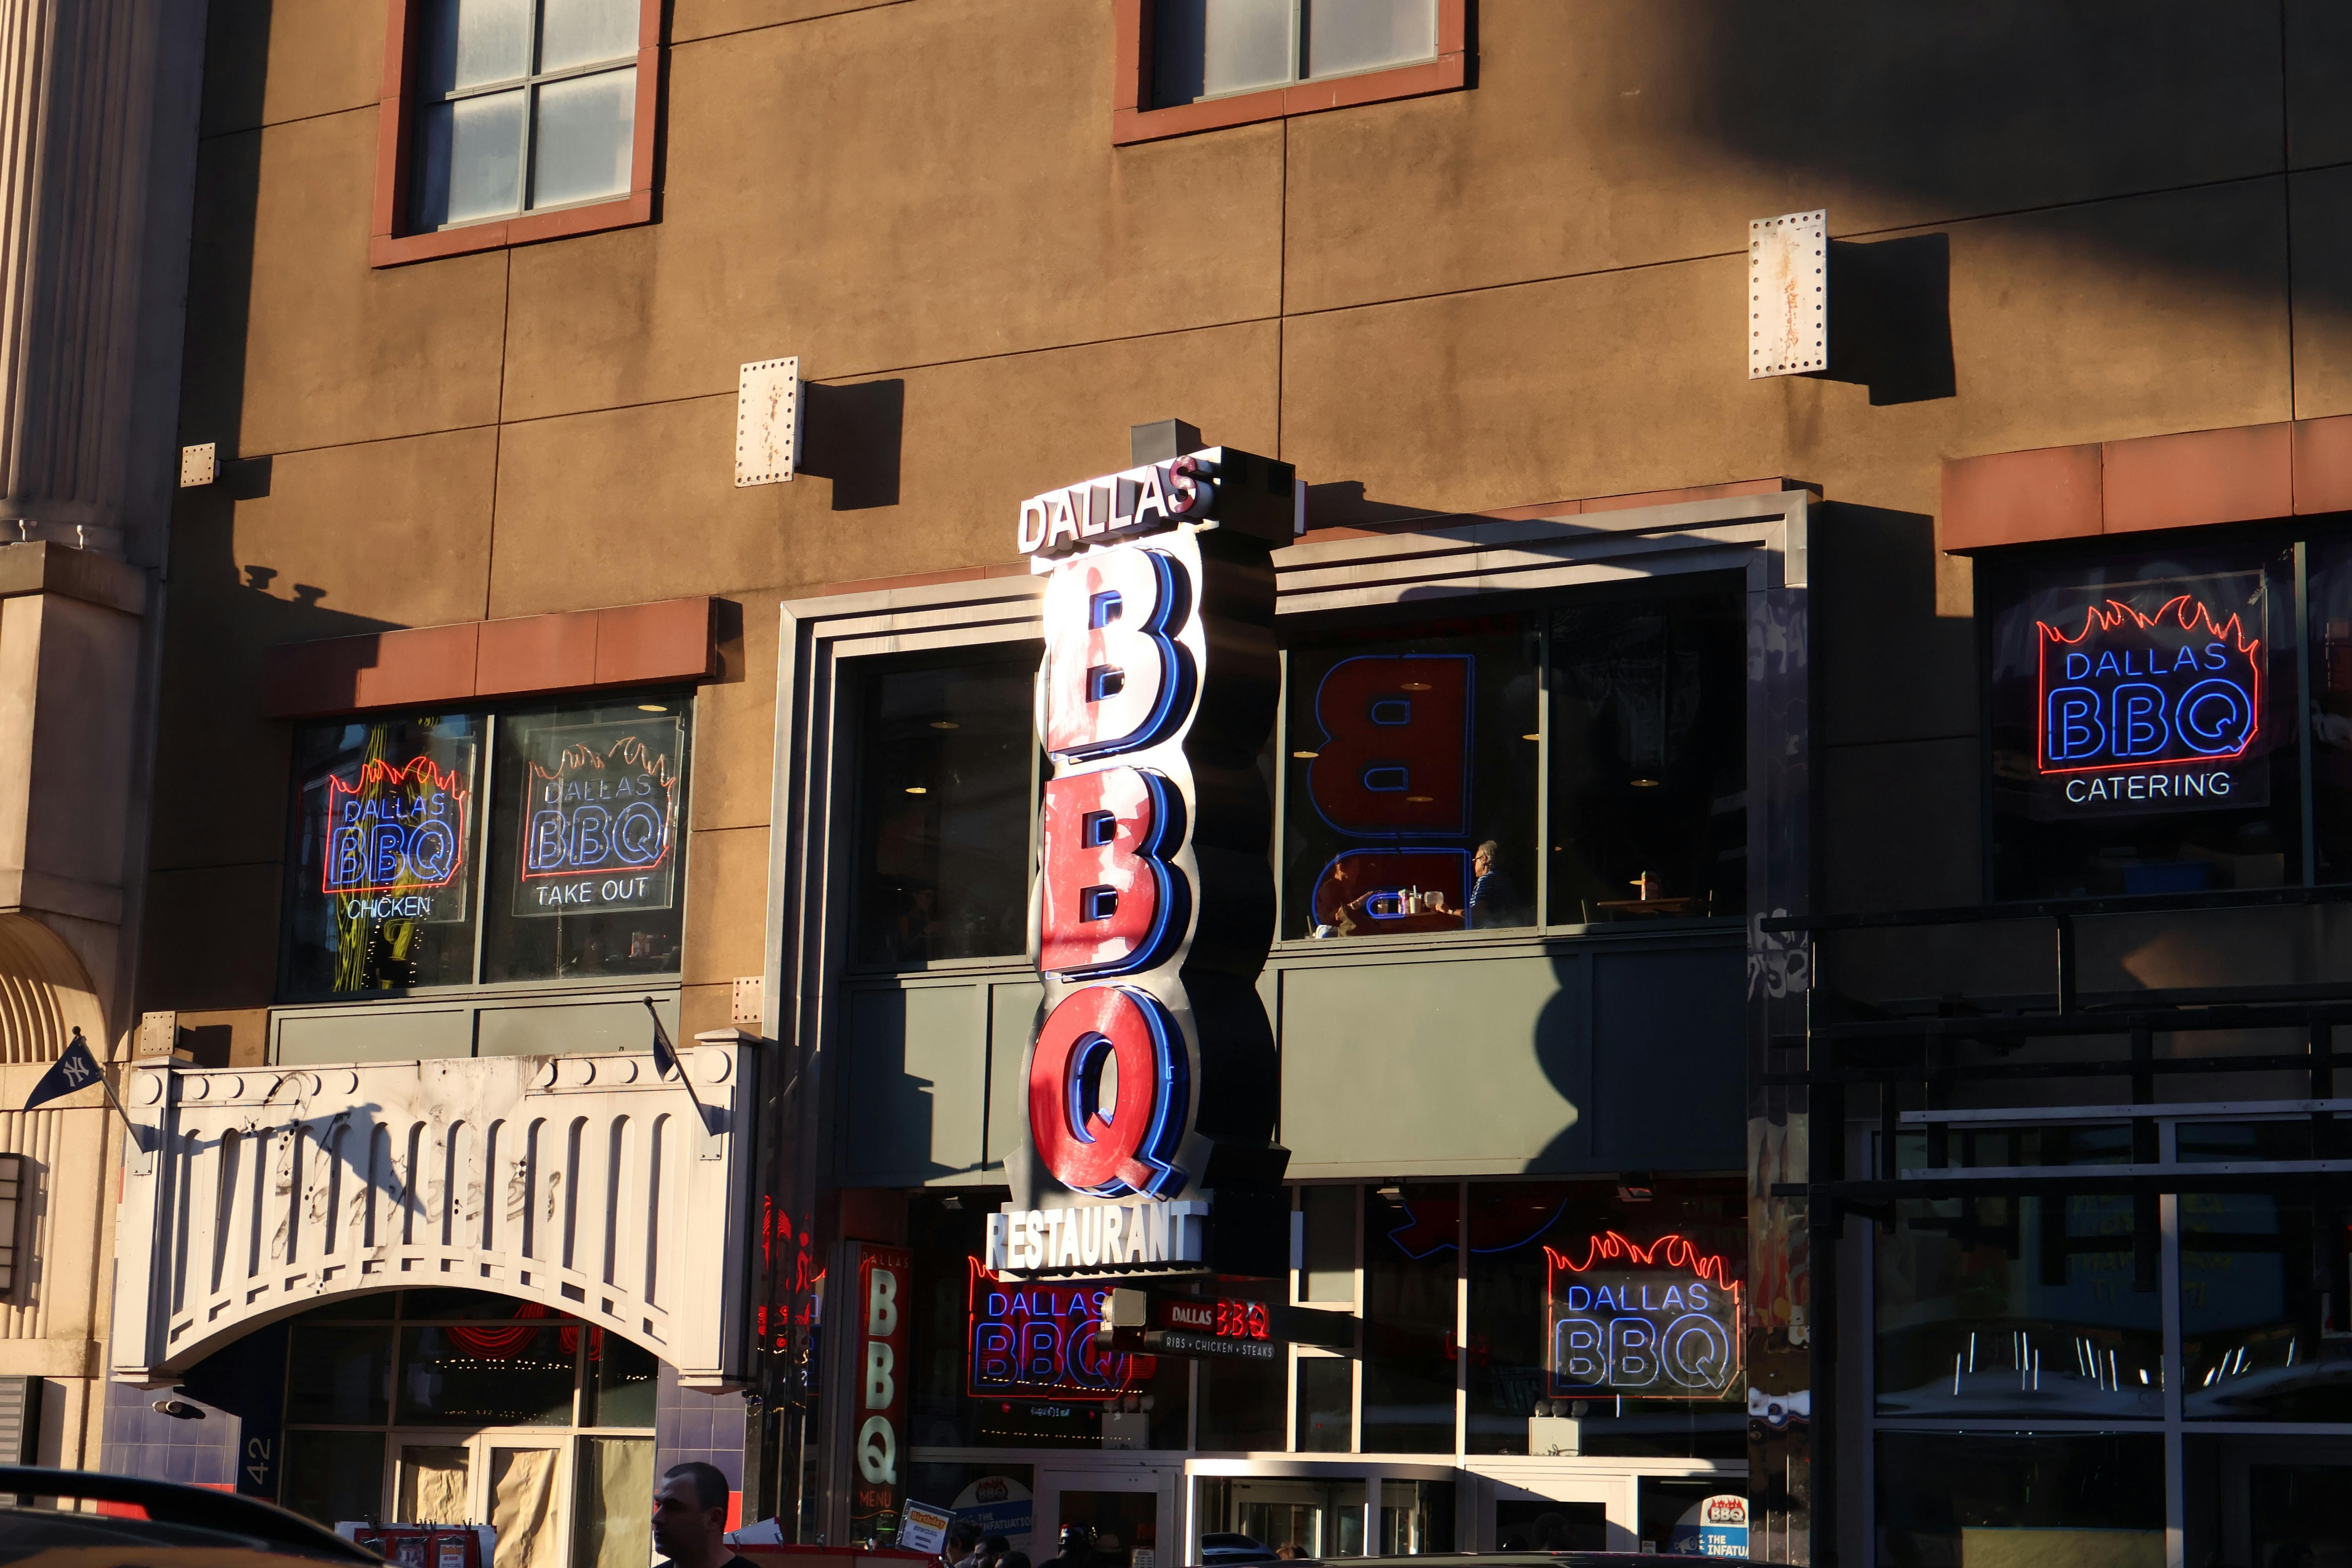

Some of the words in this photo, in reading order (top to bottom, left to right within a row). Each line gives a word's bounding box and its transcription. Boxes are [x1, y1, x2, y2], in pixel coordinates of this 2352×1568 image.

[1018, 455, 1200, 554] DALLAS
[2066, 642, 2227, 680] DALLAS
[2048, 678, 2252, 760] BBQ
[544, 773, 652, 804] DALLAS
[2066, 771, 2230, 803] CATERING
[345, 793, 445, 822] DALLAS
[528, 801, 663, 869] BBQ
[331, 819, 455, 885] BBQ
[1029, 547, 1184, 1196] BBQ
[536, 882, 592, 906] TAKE
[601, 877, 649, 901] OUT
[347, 895, 432, 920] CHICKEN
[985, 1201, 1203, 1270] RESTAURANT
[862, 1252, 909, 1269] DALLAS
[989, 1291, 1106, 1316] DALLAS
[1568, 1283, 1710, 1311] DALLAS
[1172, 1306, 1212, 1326] DALLAS
[1217, 1296, 1271, 1341] BBQ
[975, 1319, 1124, 1390] BBQ
[1166, 1336, 1186, 1349] RIBS
[1195, 1340, 1233, 1354] CHICKEN
[1242, 1345, 1272, 1358] STEAKS
[1556, 1313, 1730, 1389] BBQ
[857, 1268, 898, 1485] BBQ
[247, 1437, 271, 1485] 42
[859, 1490, 892, 1508] MENU
[1711, 1507, 1744, 1521] BBQ
[911, 1510, 946, 1530] Birthday
[978, 1512, 994, 1522] THE
[979, 1516, 1033, 1532] INFATUATIO
[1708, 1535, 1726, 1544] THE
